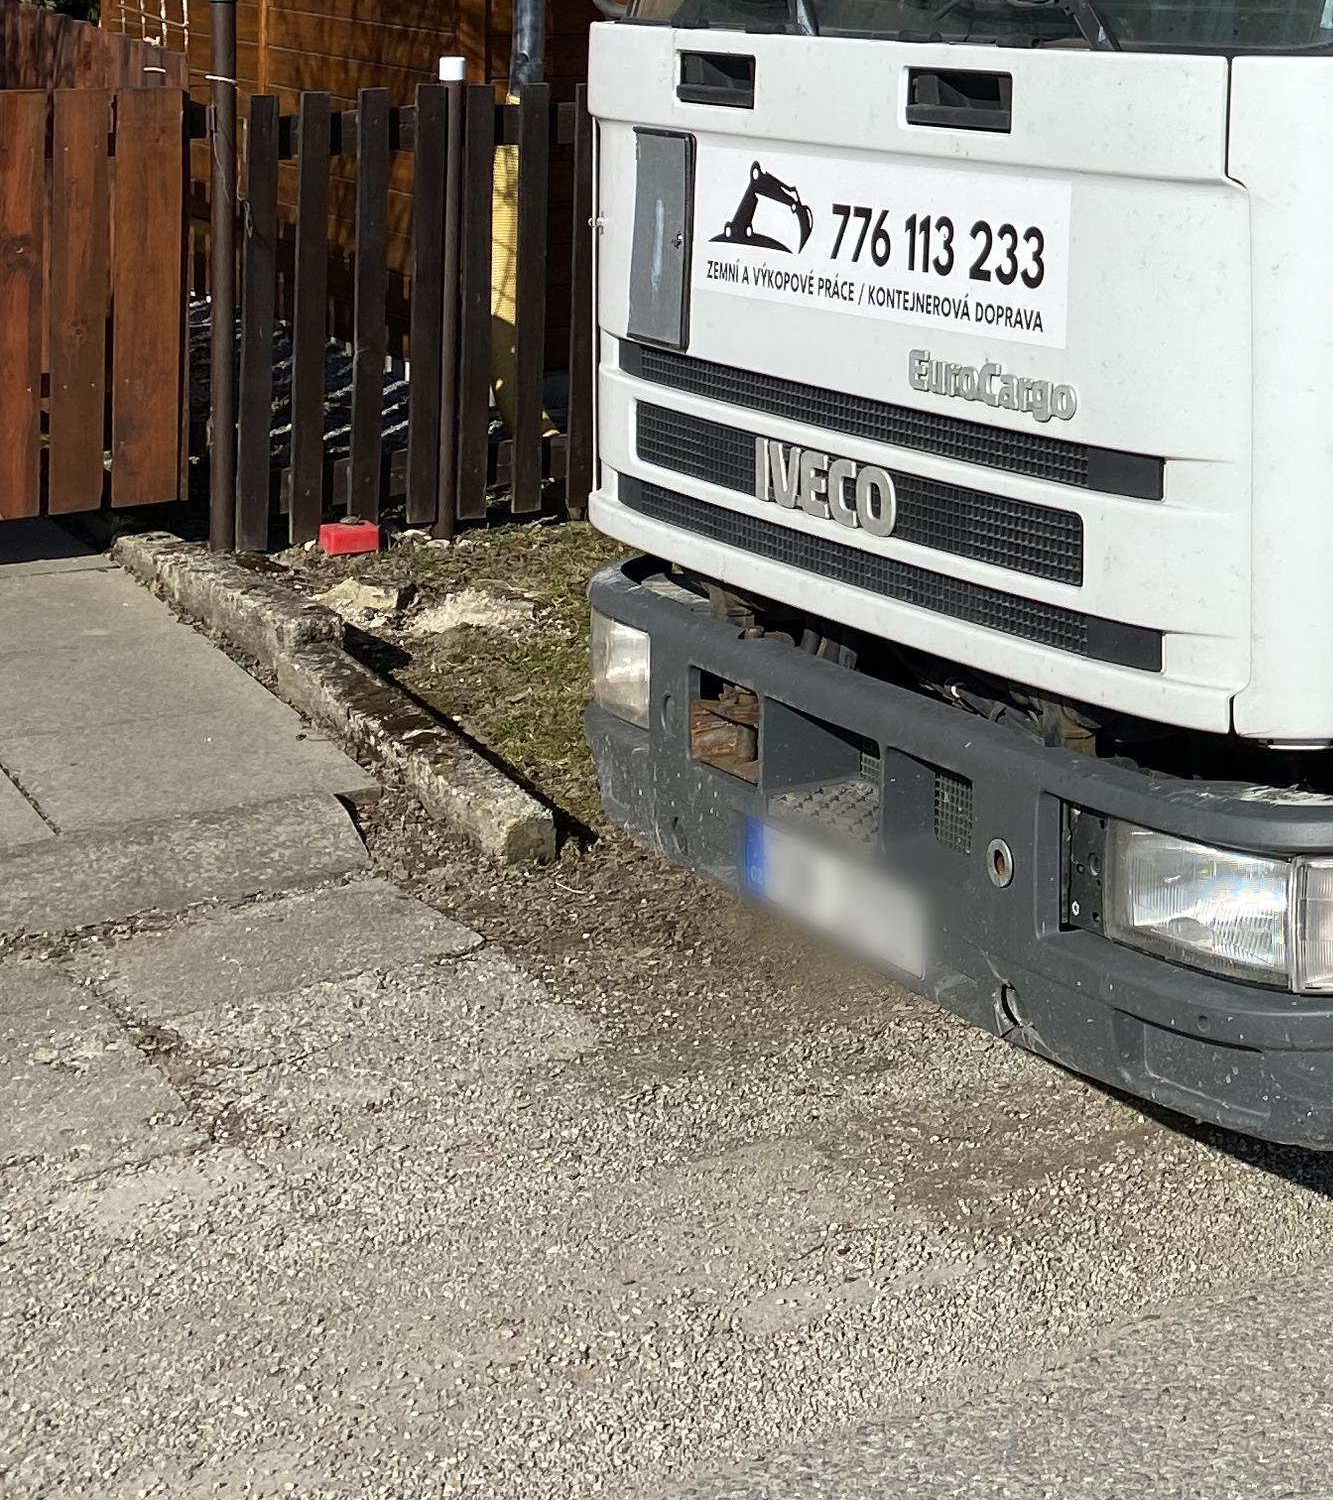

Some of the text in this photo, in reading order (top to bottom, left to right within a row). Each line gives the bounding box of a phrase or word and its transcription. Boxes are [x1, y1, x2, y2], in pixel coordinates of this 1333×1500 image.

[830, 203, 1045, 289] 776 113 233
[706, 258, 1044, 333] ZEMNÍ A VÝKOPOVÉ PRÁCE / KONTEJNEROVÁ DOPRAVA
[908, 349, 1077, 423] EuroCargo
[755, 437, 897, 538] IVECO
